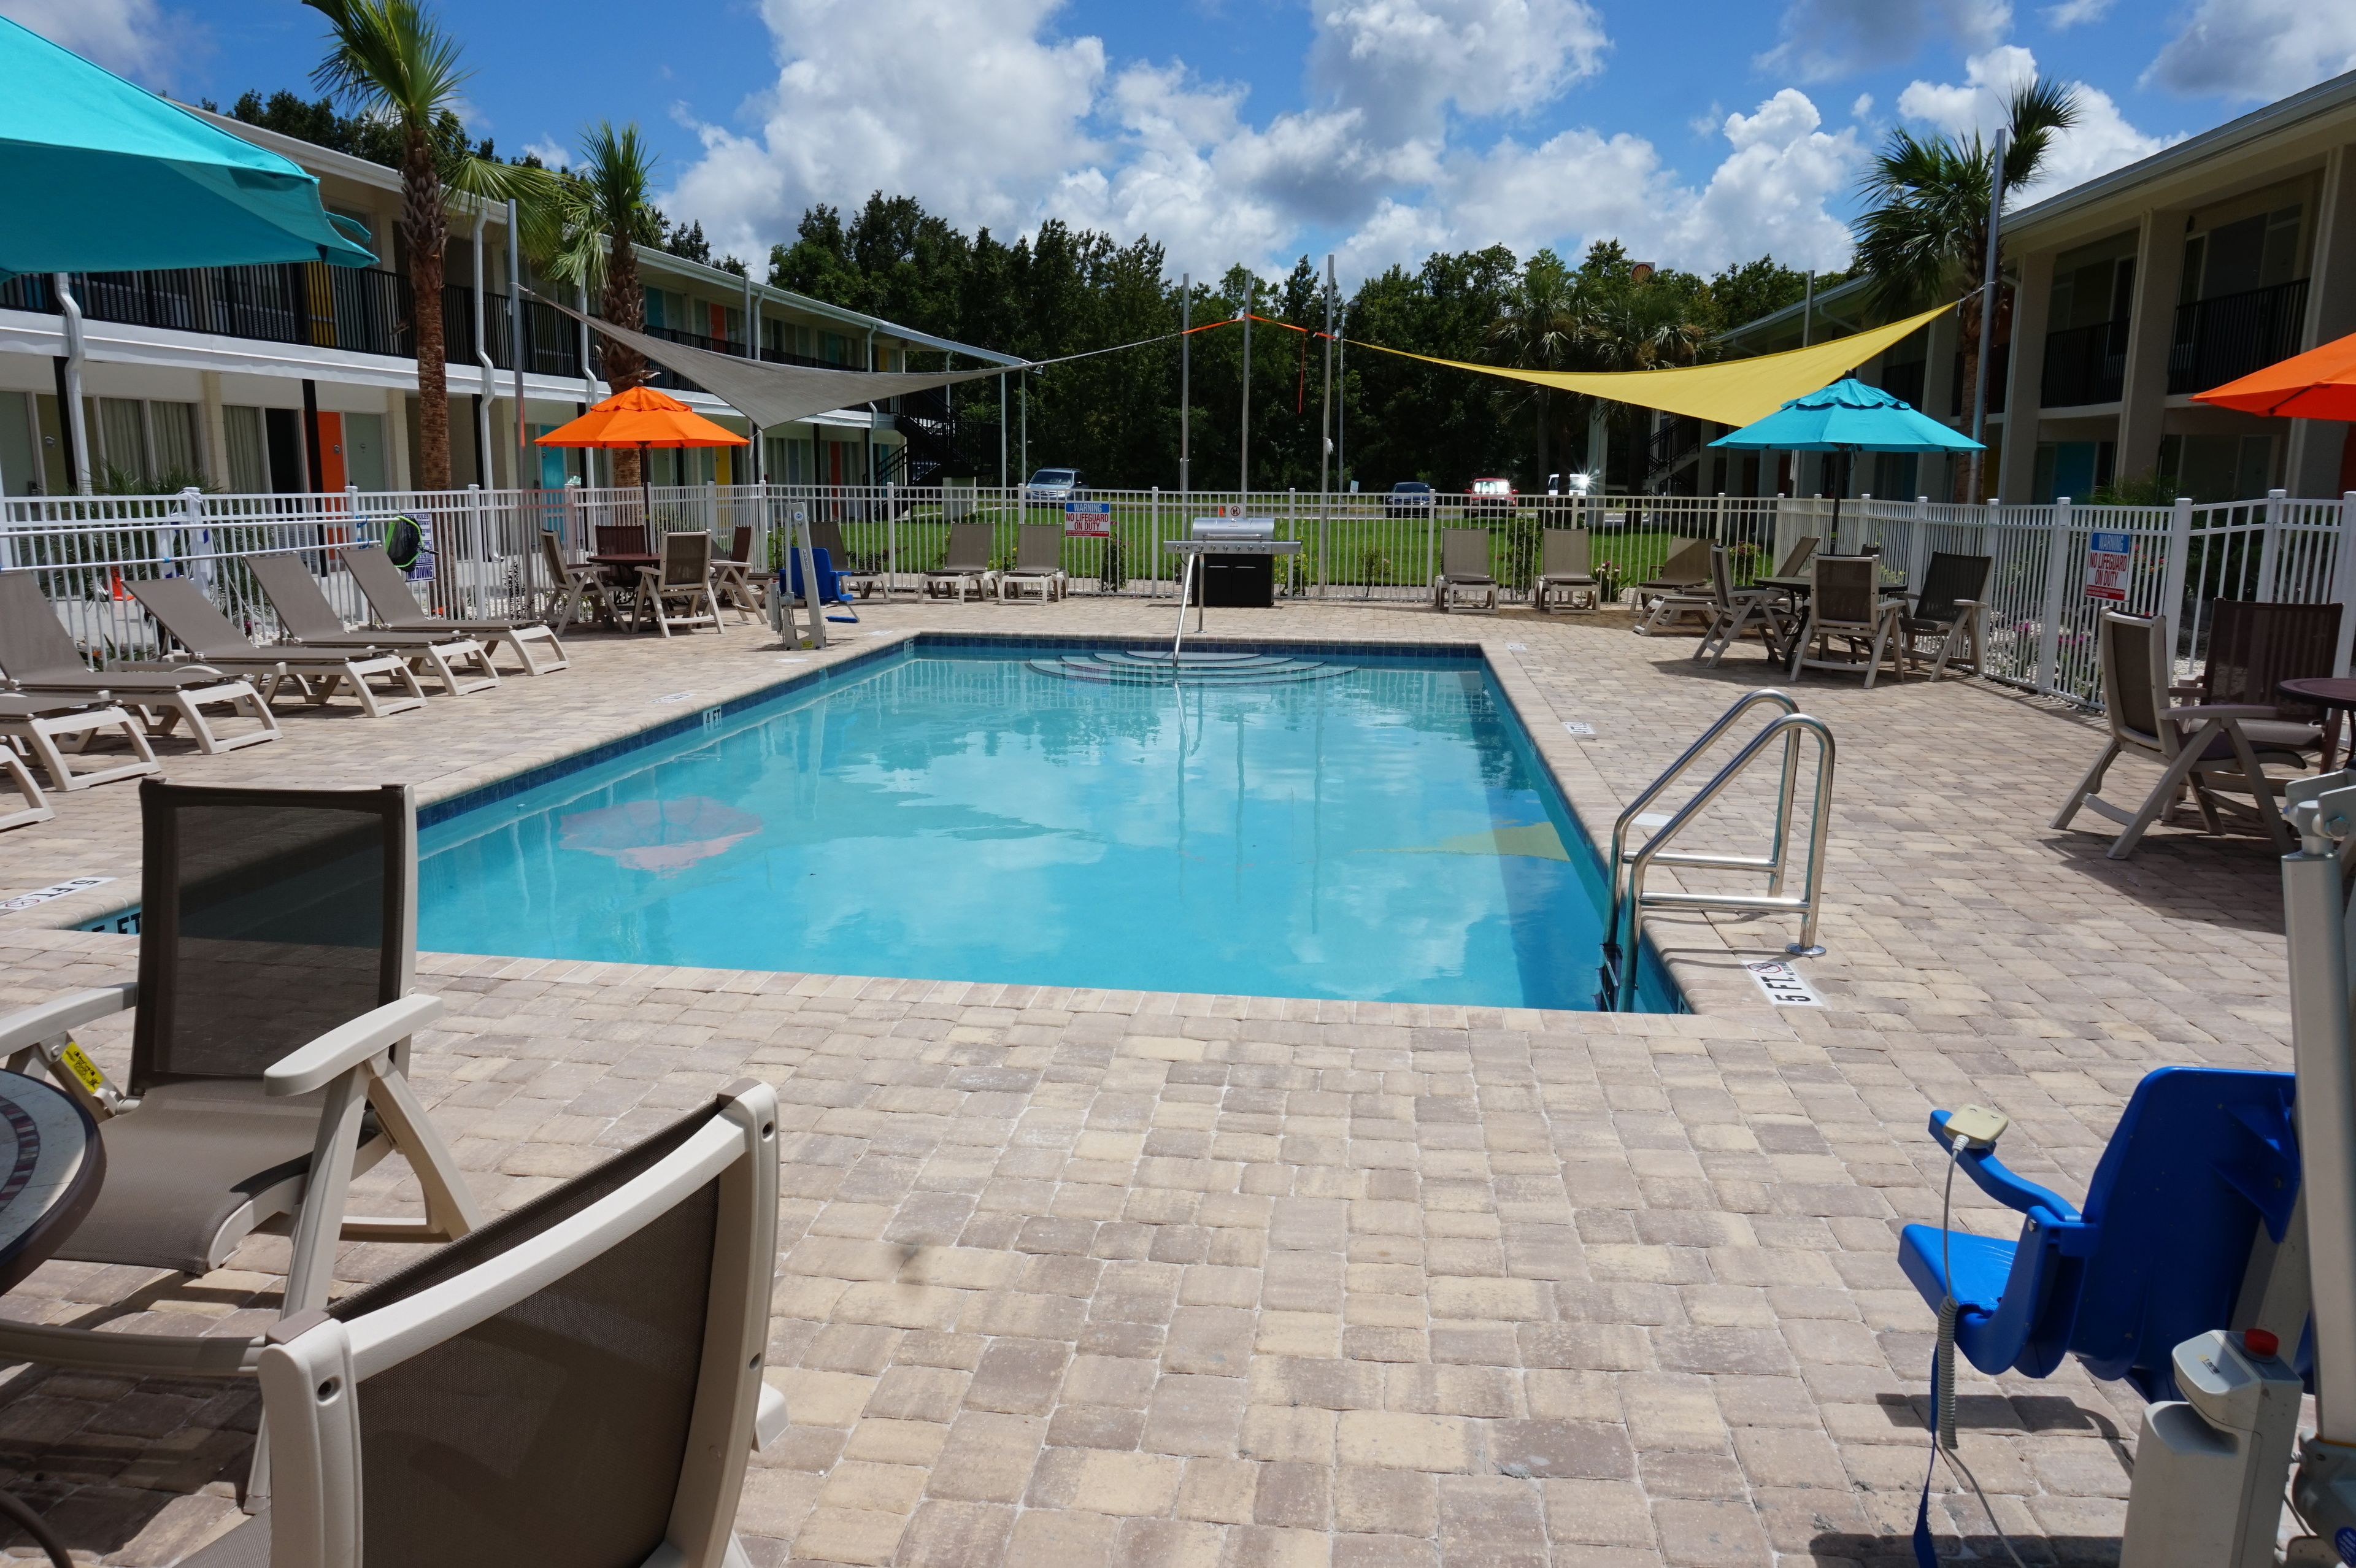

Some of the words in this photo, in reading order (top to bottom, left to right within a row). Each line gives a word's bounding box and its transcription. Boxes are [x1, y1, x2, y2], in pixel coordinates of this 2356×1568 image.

[1074, 503, 1102, 512] WARNING
[2099, 534, 2123, 551] WARNING
[2089, 553, 2097, 568] NO
[2098, 553, 2127, 571] LIFEGUARD
[408, 570, 415, 579] NO
[417, 566, 433, 579] DIVING
[2095, 569, 2102, 585] ON
[2104, 571, 2118, 587] DUTY
[706, 713, 710, 723] 4
[713, 709, 720, 721] FT
